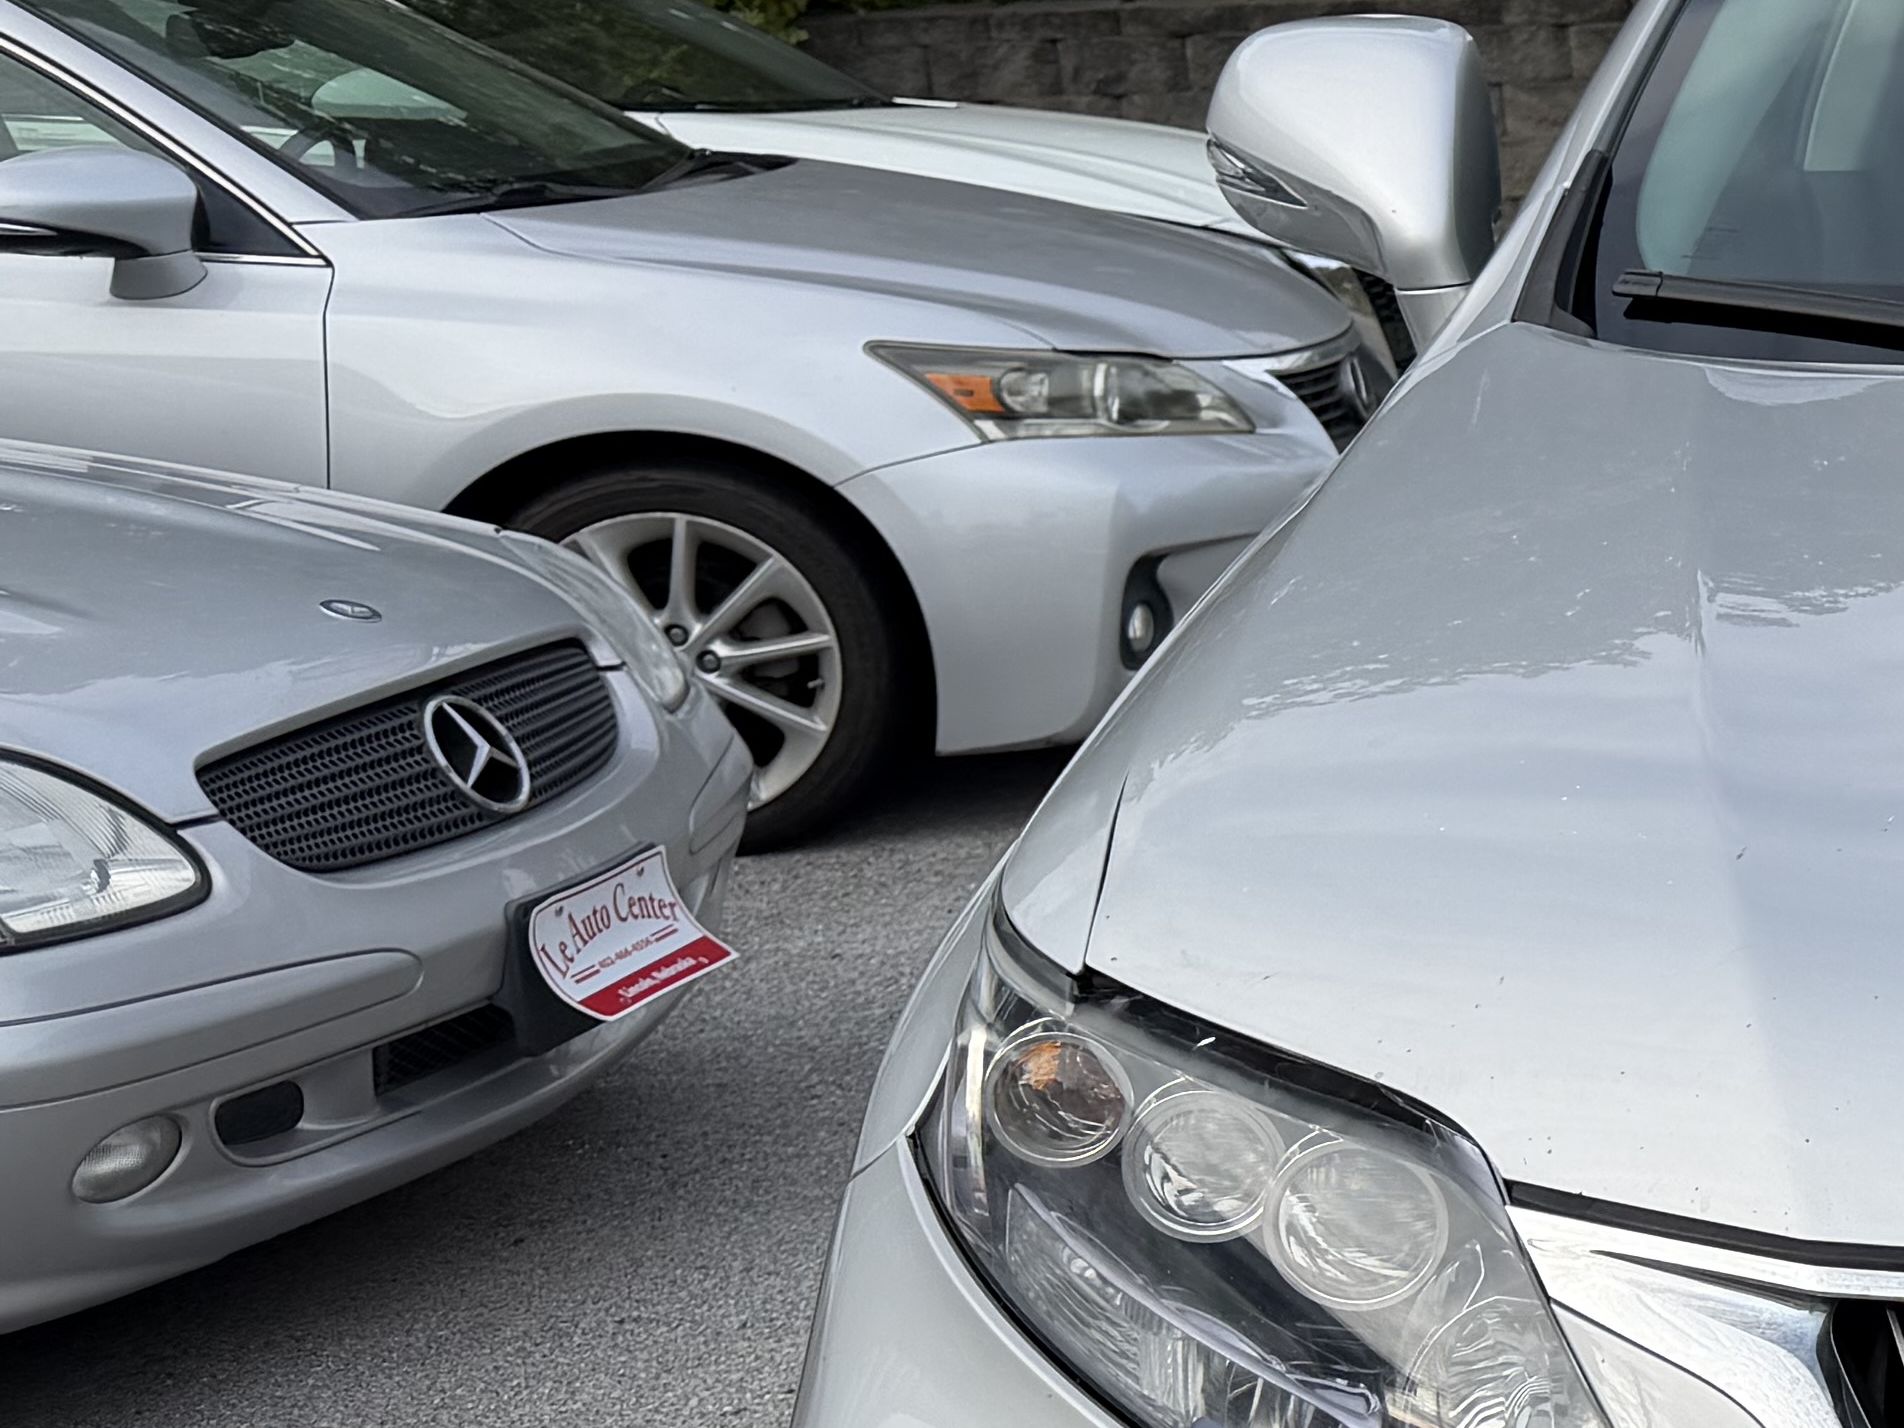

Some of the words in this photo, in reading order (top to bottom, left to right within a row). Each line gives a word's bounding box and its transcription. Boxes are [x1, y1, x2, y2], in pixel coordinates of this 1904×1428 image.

[540, 942, 575, 980] Le
[566, 905, 611, 955] Auto
[612, 882, 680, 923] Center
